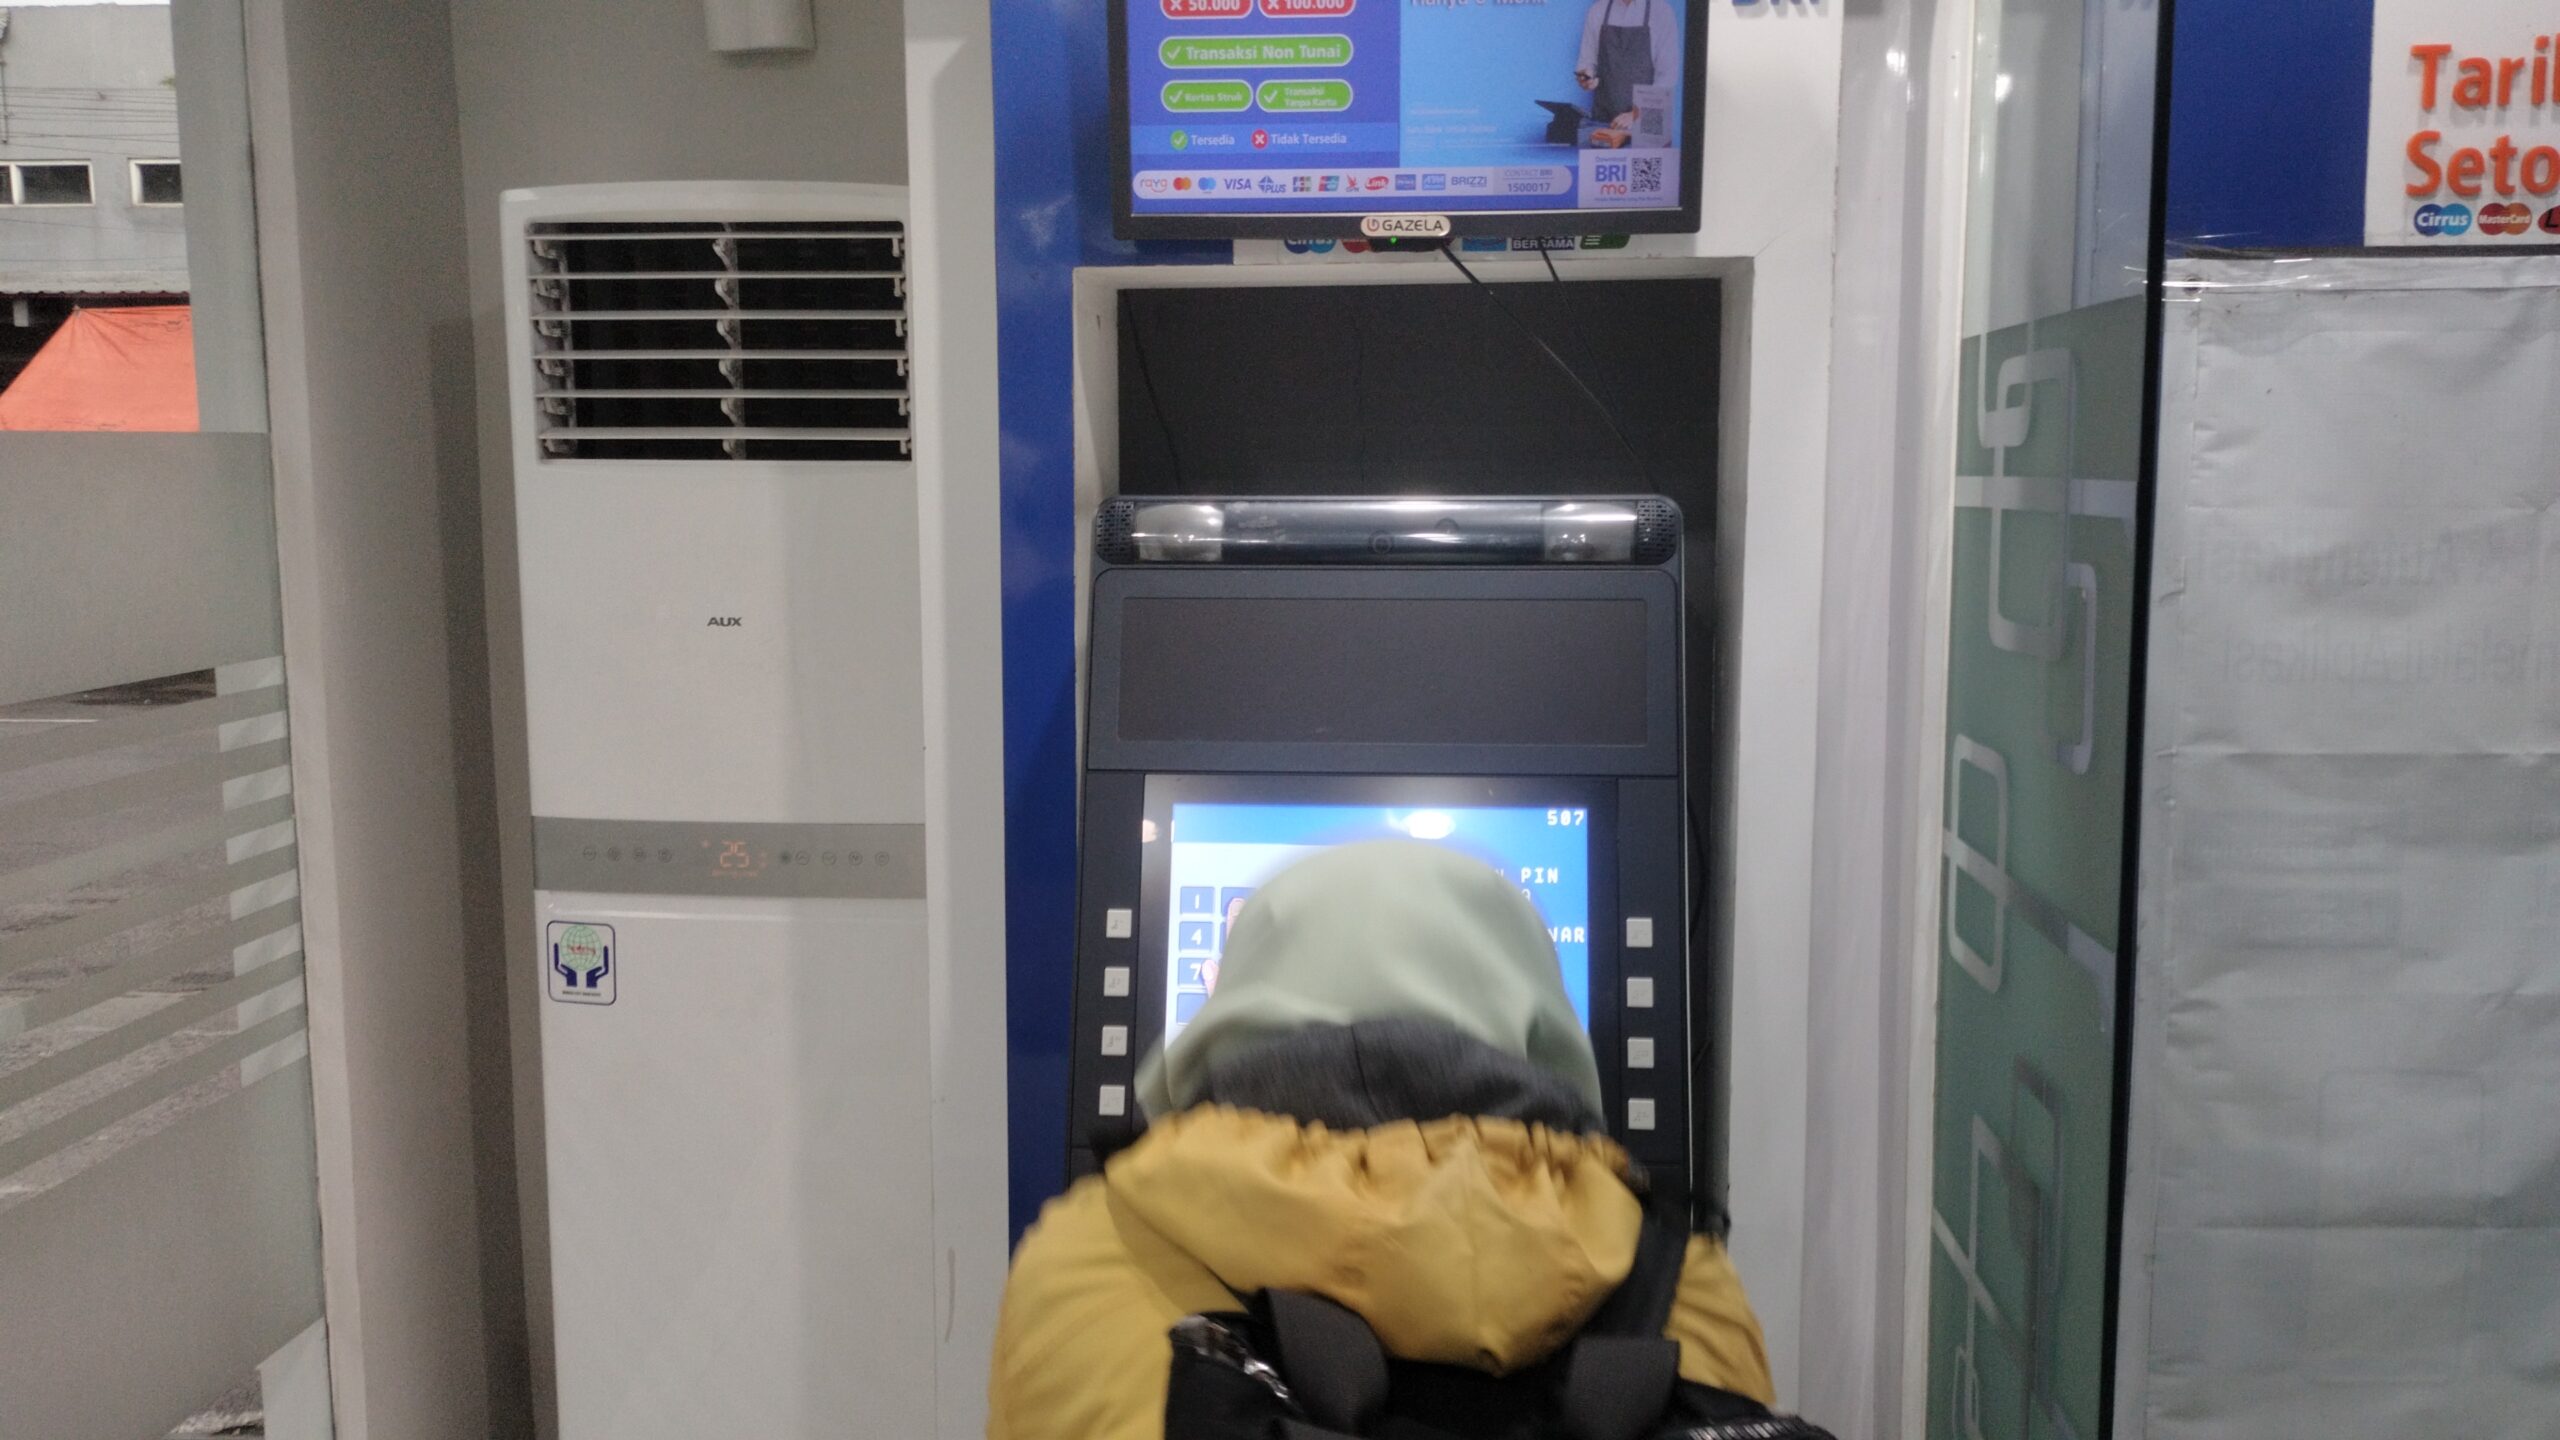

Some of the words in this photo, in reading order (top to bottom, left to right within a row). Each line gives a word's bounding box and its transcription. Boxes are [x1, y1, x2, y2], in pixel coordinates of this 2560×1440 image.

[1188, 0, 1241, 11] 50.000
[1286, 0, 1345, 10] 100.000
[1187, 46, 1257, 61] Transaksi
[1263, 46, 1294, 60] Non
[1299, 44, 1341, 59] Tunai
[1185, 92, 1215, 102] Kertas
[1217, 91, 1243, 101] Struk
[1191, 134, 1236, 146] Tersedia
[1271, 133, 1299, 145] Tidak
[1302, 132, 1347, 145] Tersedia
[1595, 165, 1627, 182] BRI
[1224, 178, 1252, 191] VISA
[1451, 176, 1488, 186] BRIZZI
[1507, 182, 1551, 193] 1500017
[1600, 184, 1627, 195] mo
[1382, 219, 1444, 232] GAZELA
[2417, 212, 2469, 226] Cirrus
[2478, 214, 2531, 225] MasterCard
[707, 616, 743, 627] AUX
[1547, 809, 1585, 826] 507
[720, 840, 750, 868] 25
[1520, 867, 1559, 884] PIN
[1194, 894, 1200, 910] 1
[1191, 928, 1203, 945] 4
[1190, 963, 1202, 981] 7
